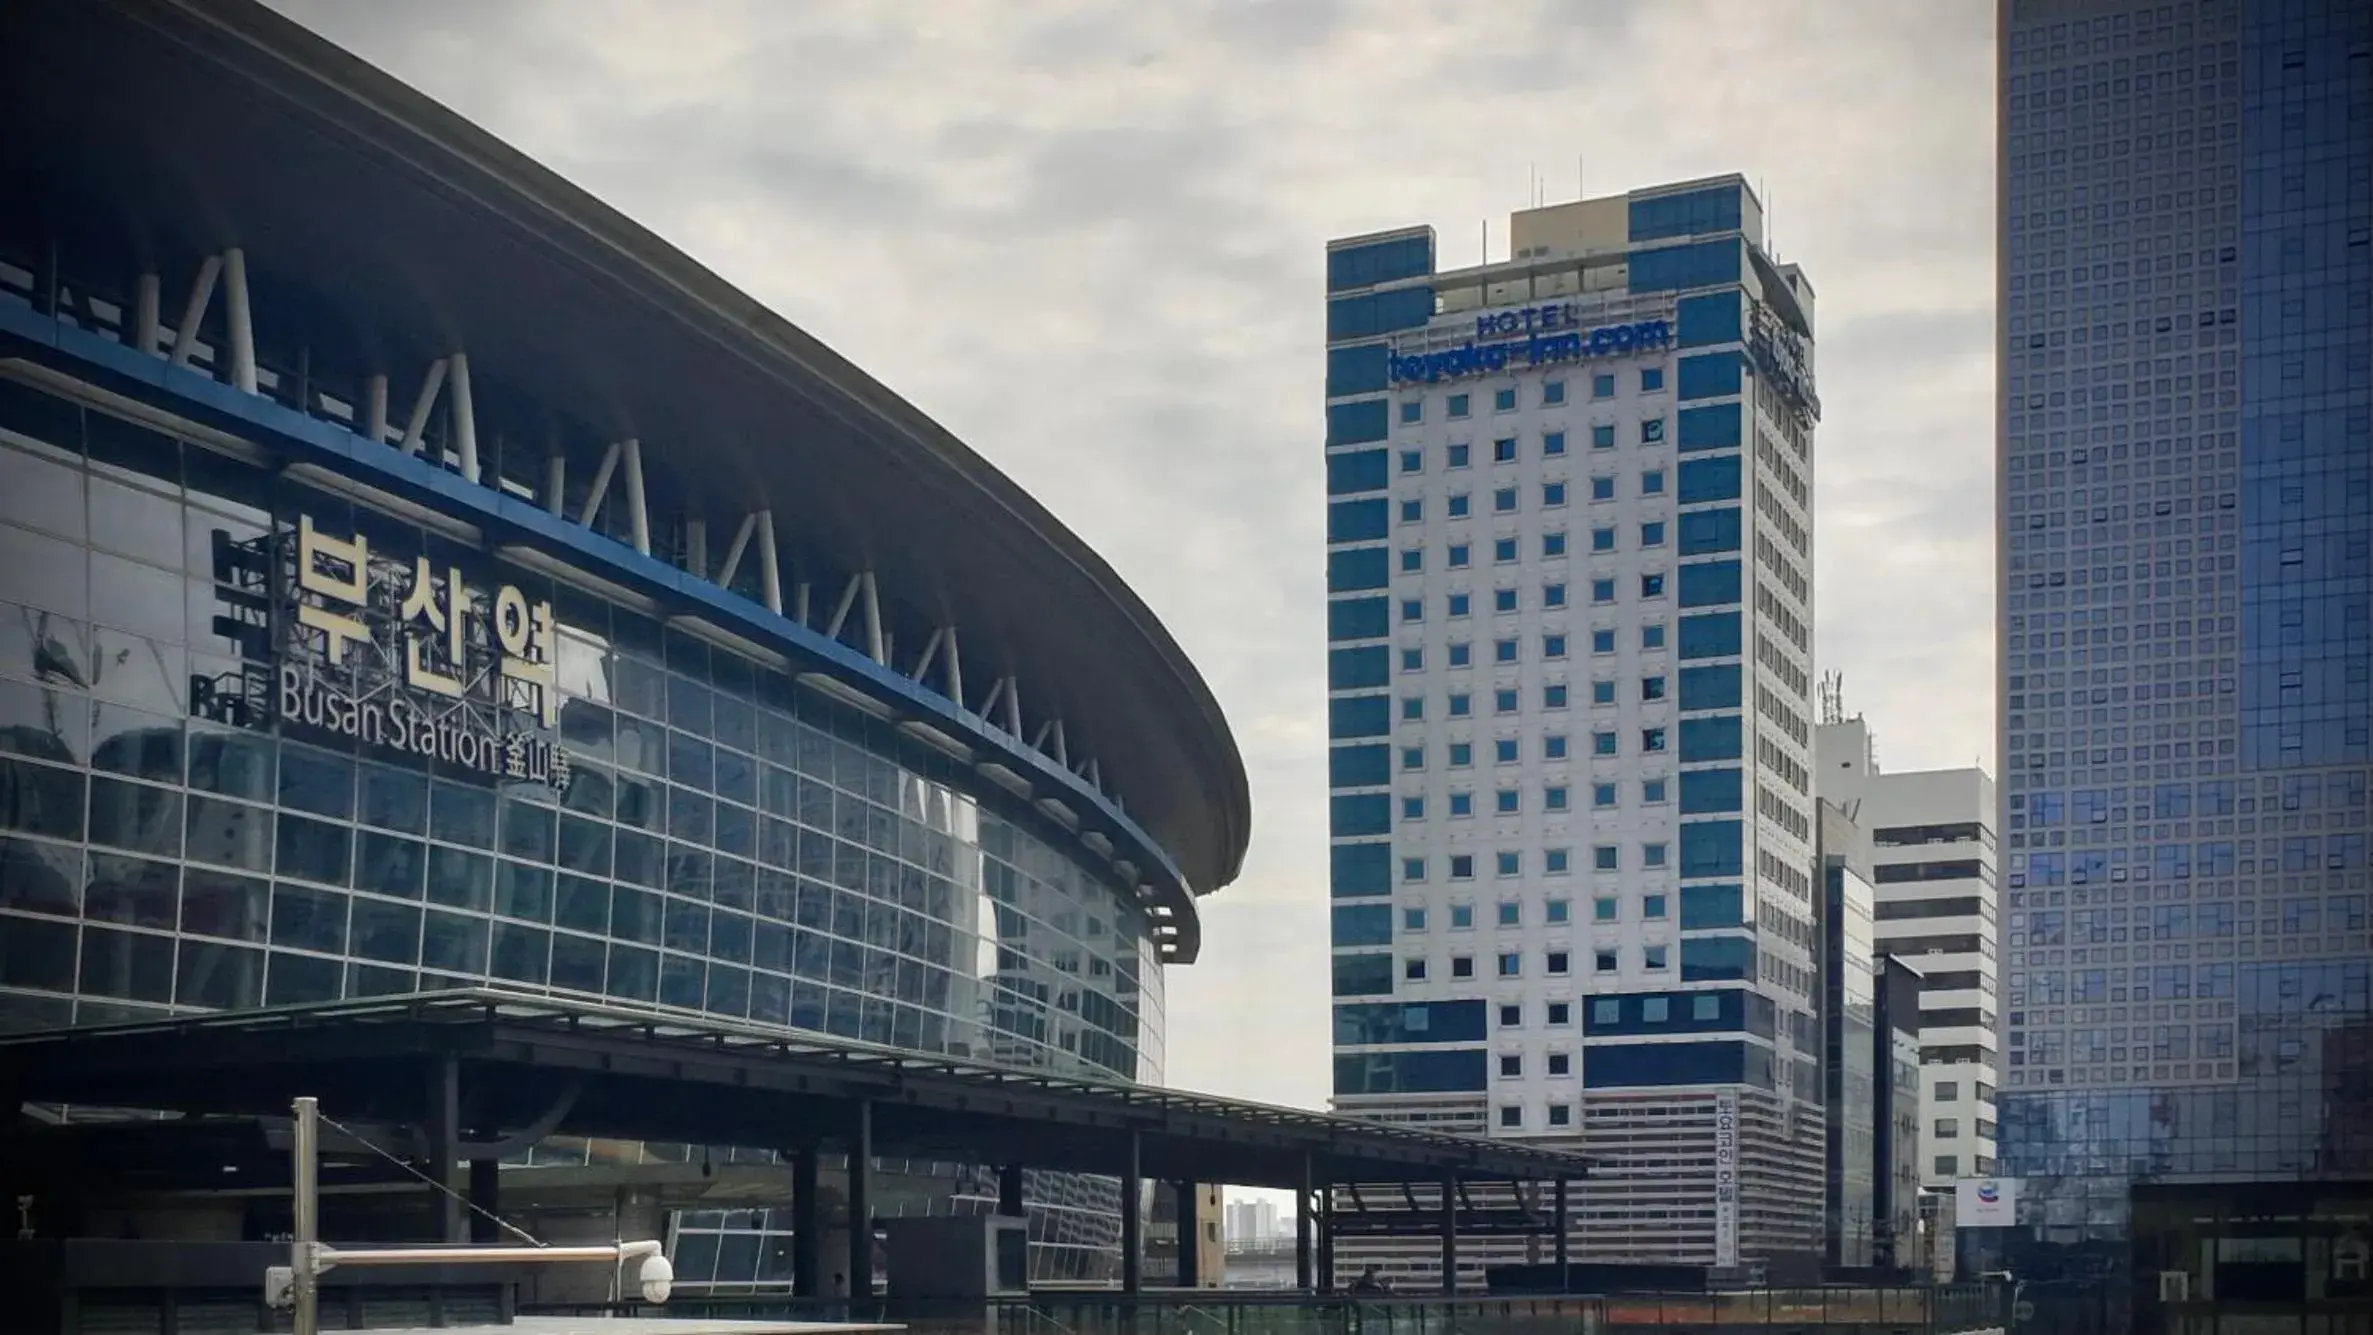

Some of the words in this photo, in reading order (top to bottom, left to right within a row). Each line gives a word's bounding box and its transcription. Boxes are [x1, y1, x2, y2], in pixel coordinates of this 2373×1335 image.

[1477, 303, 1578, 336] HOTEL
[300, 514, 557, 730] 부산역
[280, 663, 384, 744] Busan
[389, 698, 499, 774] Station
